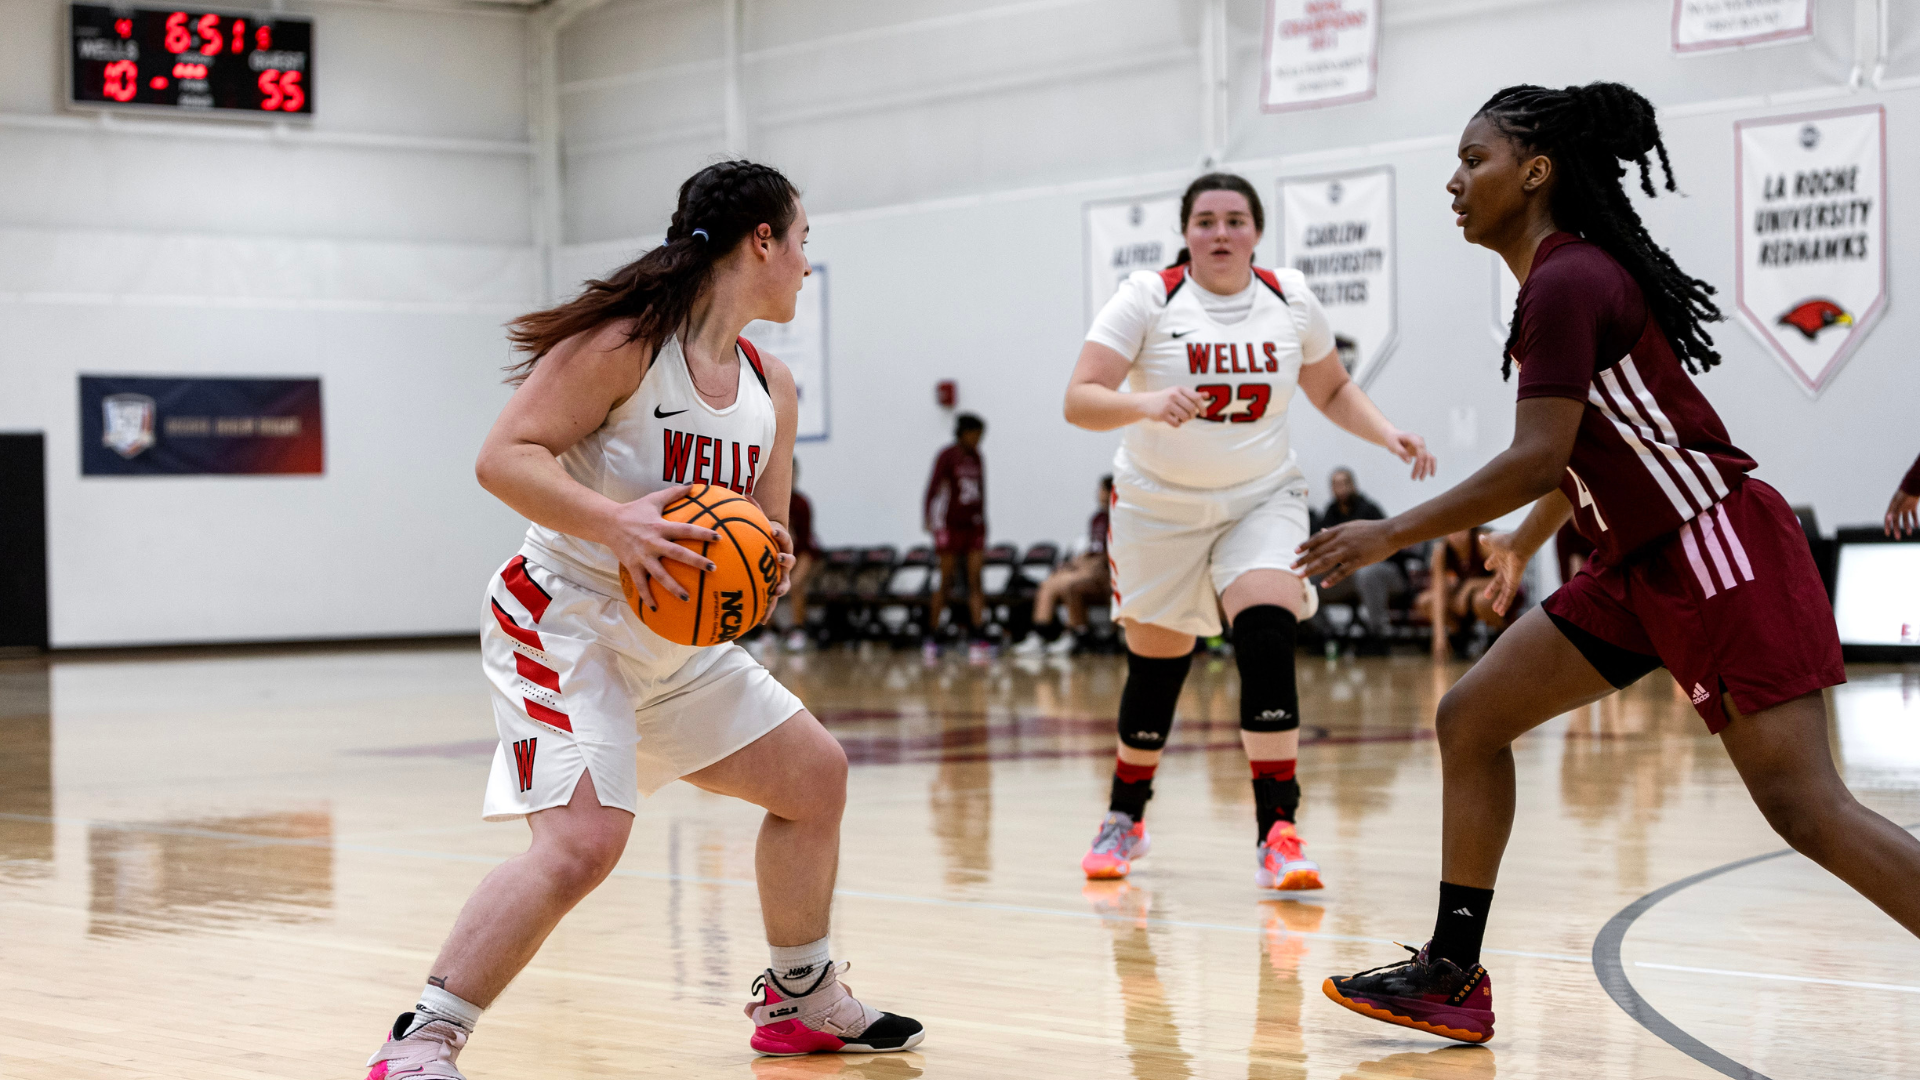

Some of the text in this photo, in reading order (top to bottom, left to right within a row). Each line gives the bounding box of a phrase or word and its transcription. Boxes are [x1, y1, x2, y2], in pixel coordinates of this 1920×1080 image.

[258, 69, 305, 111] 55
[1763, 166, 1859, 201] LA ROCHE
[1304, 220, 1369, 248] CARLOW
[1754, 201, 1872, 236] UNIVERSITY
[1759, 234, 1868, 267] REDHAWKS
[1186, 342, 1278, 374] WELLS
[1195, 383, 1272, 423] 23
[663, 428, 760, 494] WELLS
[714, 590, 743, 645] NCAA
[1692, 691, 1711, 705] adidas
[512, 737, 538, 793] W
[788, 964, 814, 977] NIKE
